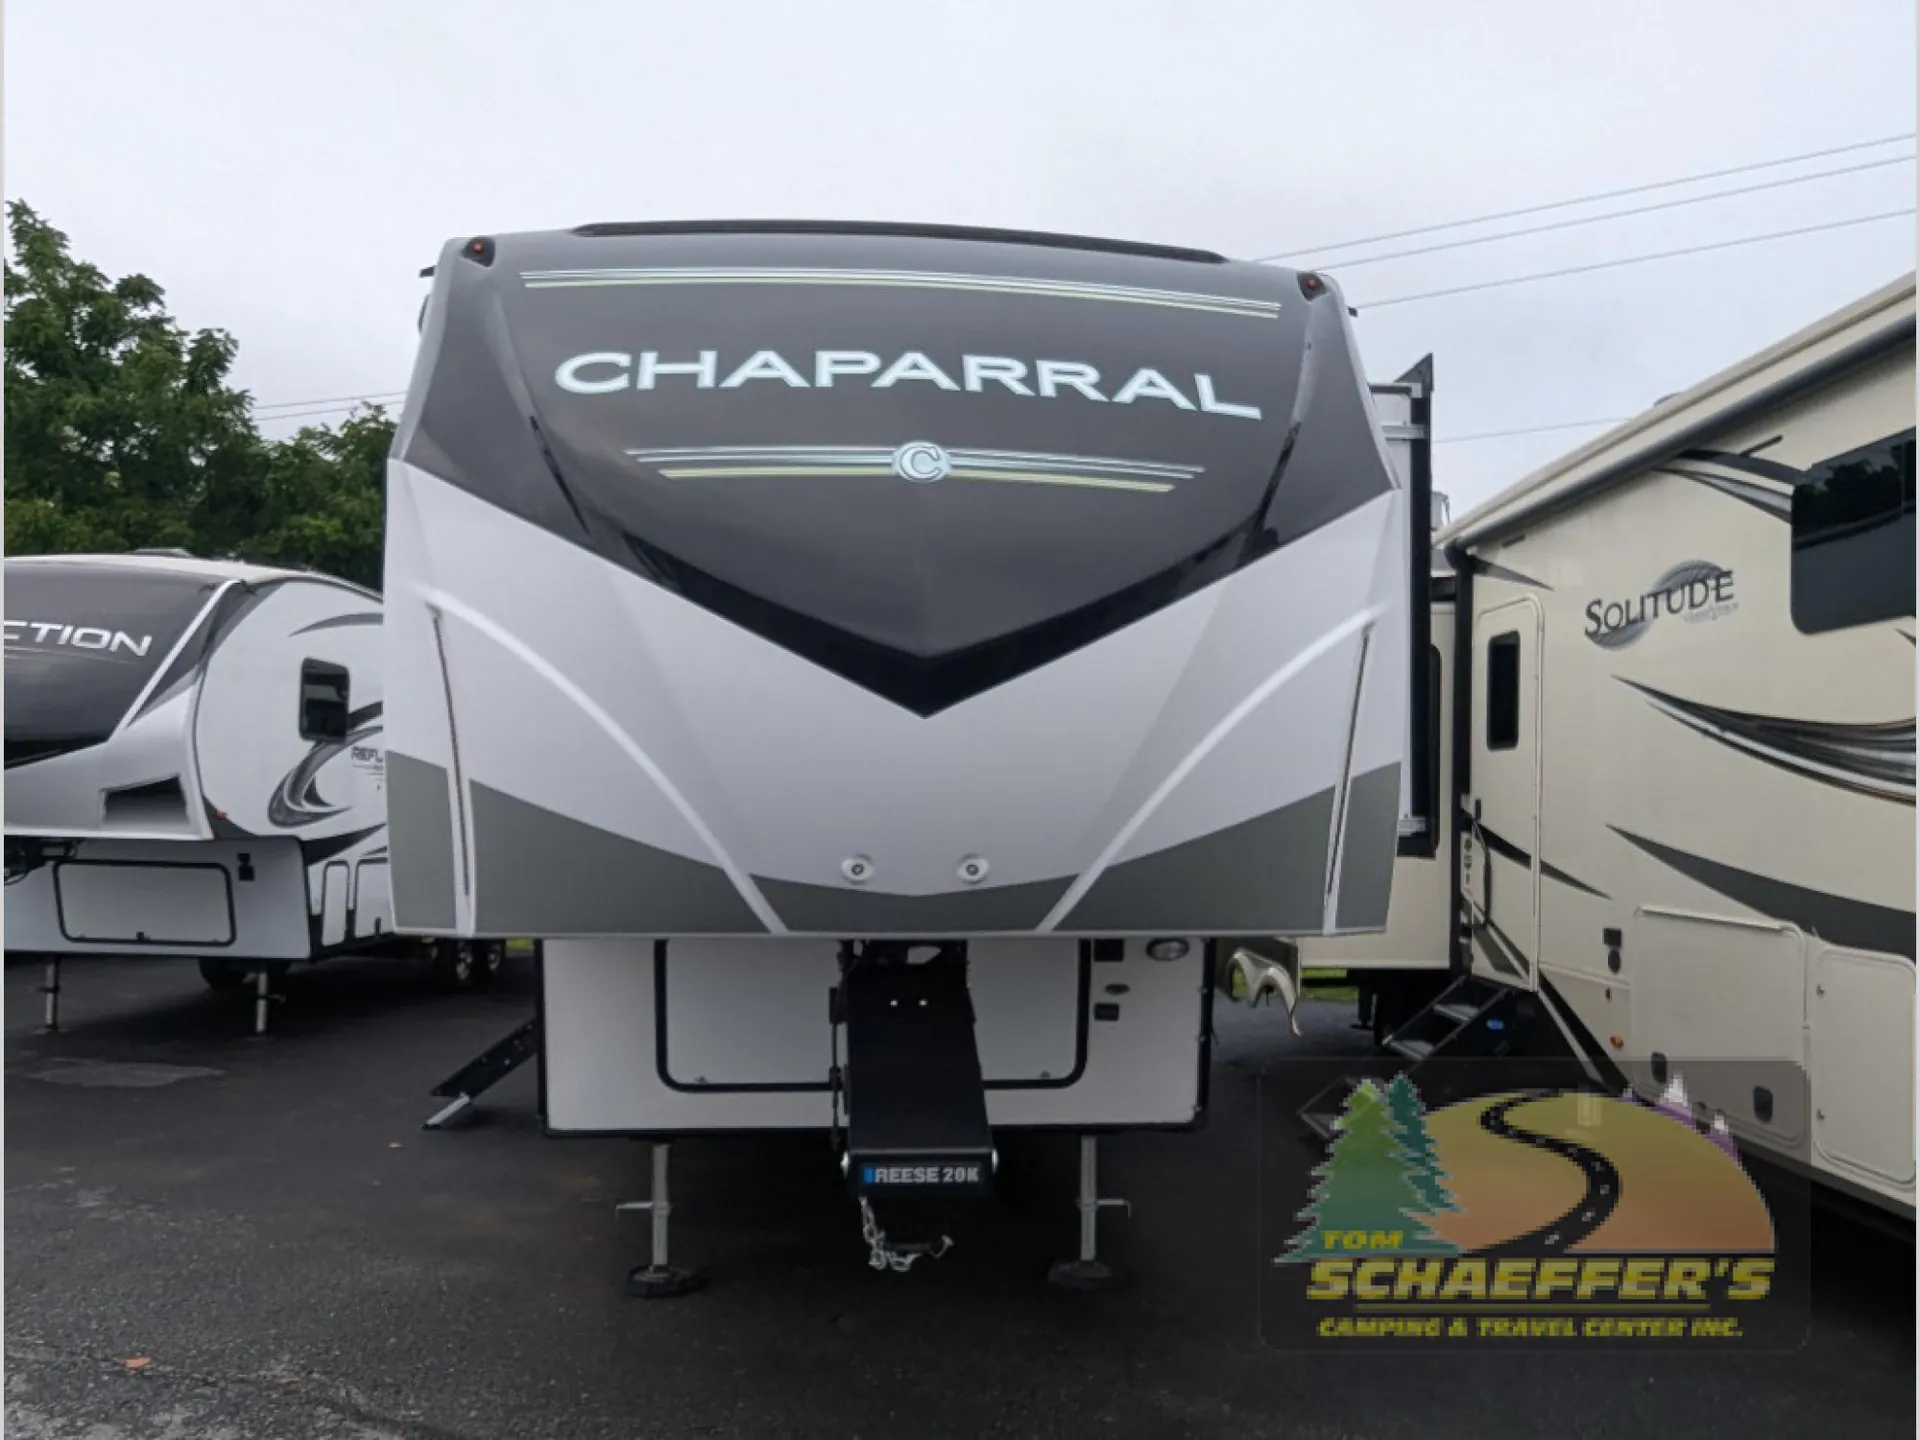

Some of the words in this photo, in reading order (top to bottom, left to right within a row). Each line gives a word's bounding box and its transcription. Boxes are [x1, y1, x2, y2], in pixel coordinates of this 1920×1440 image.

[554, 349, 1262, 420] CHAPARRAL
[900, 446, 943, 480] C
[1584, 569, 1735, 637] SOLITUDE
[874, 1166, 939, 1184] REESE
[942, 1166, 979, 1183] 20K
